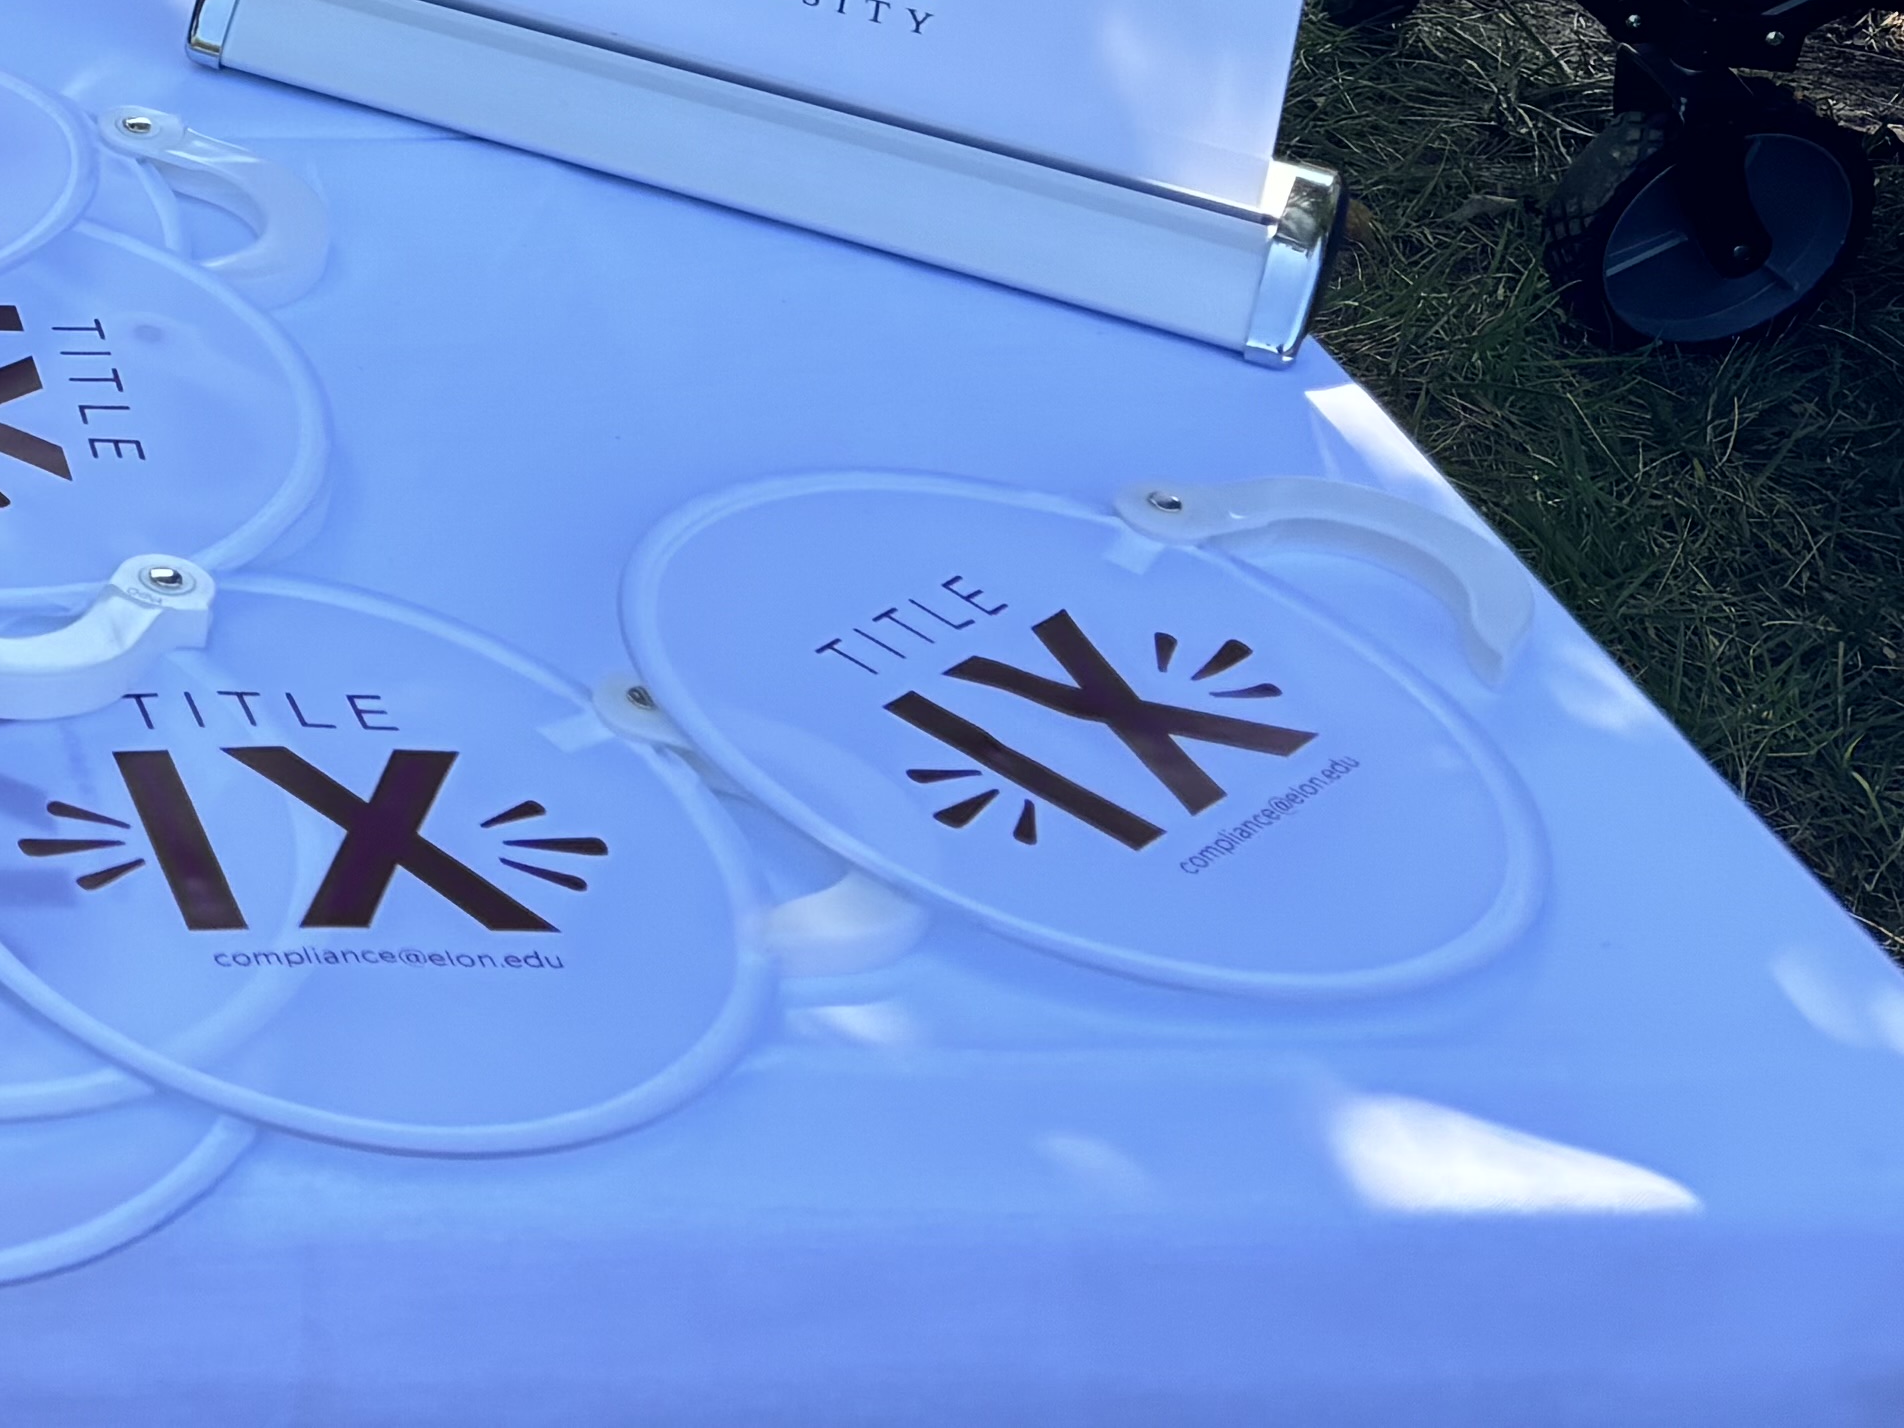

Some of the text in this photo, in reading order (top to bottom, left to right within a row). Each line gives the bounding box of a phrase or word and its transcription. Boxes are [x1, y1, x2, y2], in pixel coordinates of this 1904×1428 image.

[50, 319, 146, 462] TITLE
[815, 574, 1009, 677] TITLE
[126, 691, 403, 734] TITLE
[883, 609, 1319, 850] IX
[112, 746, 560, 933] IX
[1179, 754, 1362, 875] compliance@elon.edu
[212, 943, 566, 972] compliance@elon.edu
